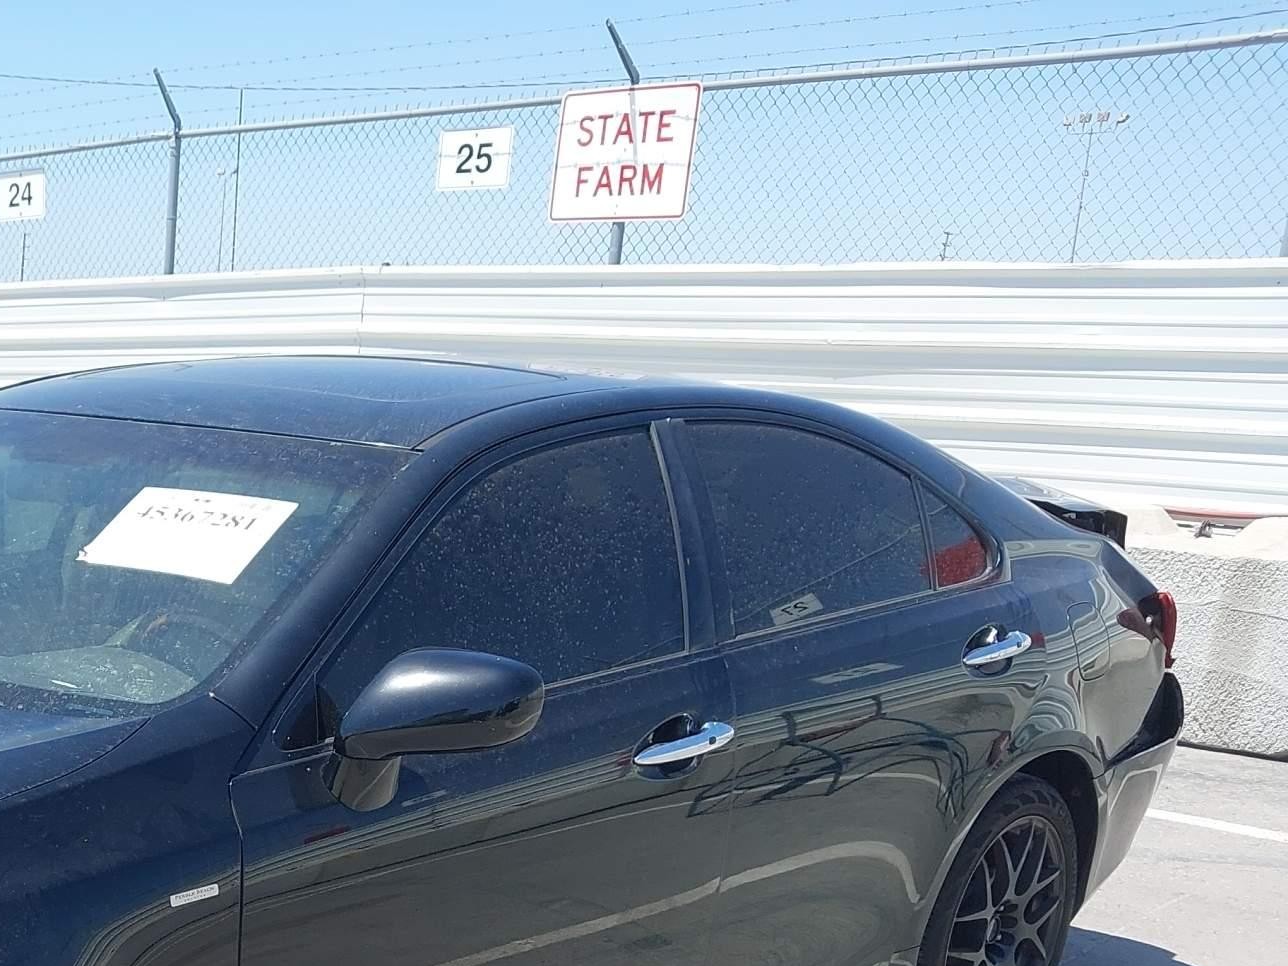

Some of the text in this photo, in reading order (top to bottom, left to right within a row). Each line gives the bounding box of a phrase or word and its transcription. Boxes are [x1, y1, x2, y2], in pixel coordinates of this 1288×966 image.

[576, 109, 677, 147] STATE
[455, 143, 492, 174] 25
[8, 181, 33, 208] 24
[575, 163, 665, 198] FARM
